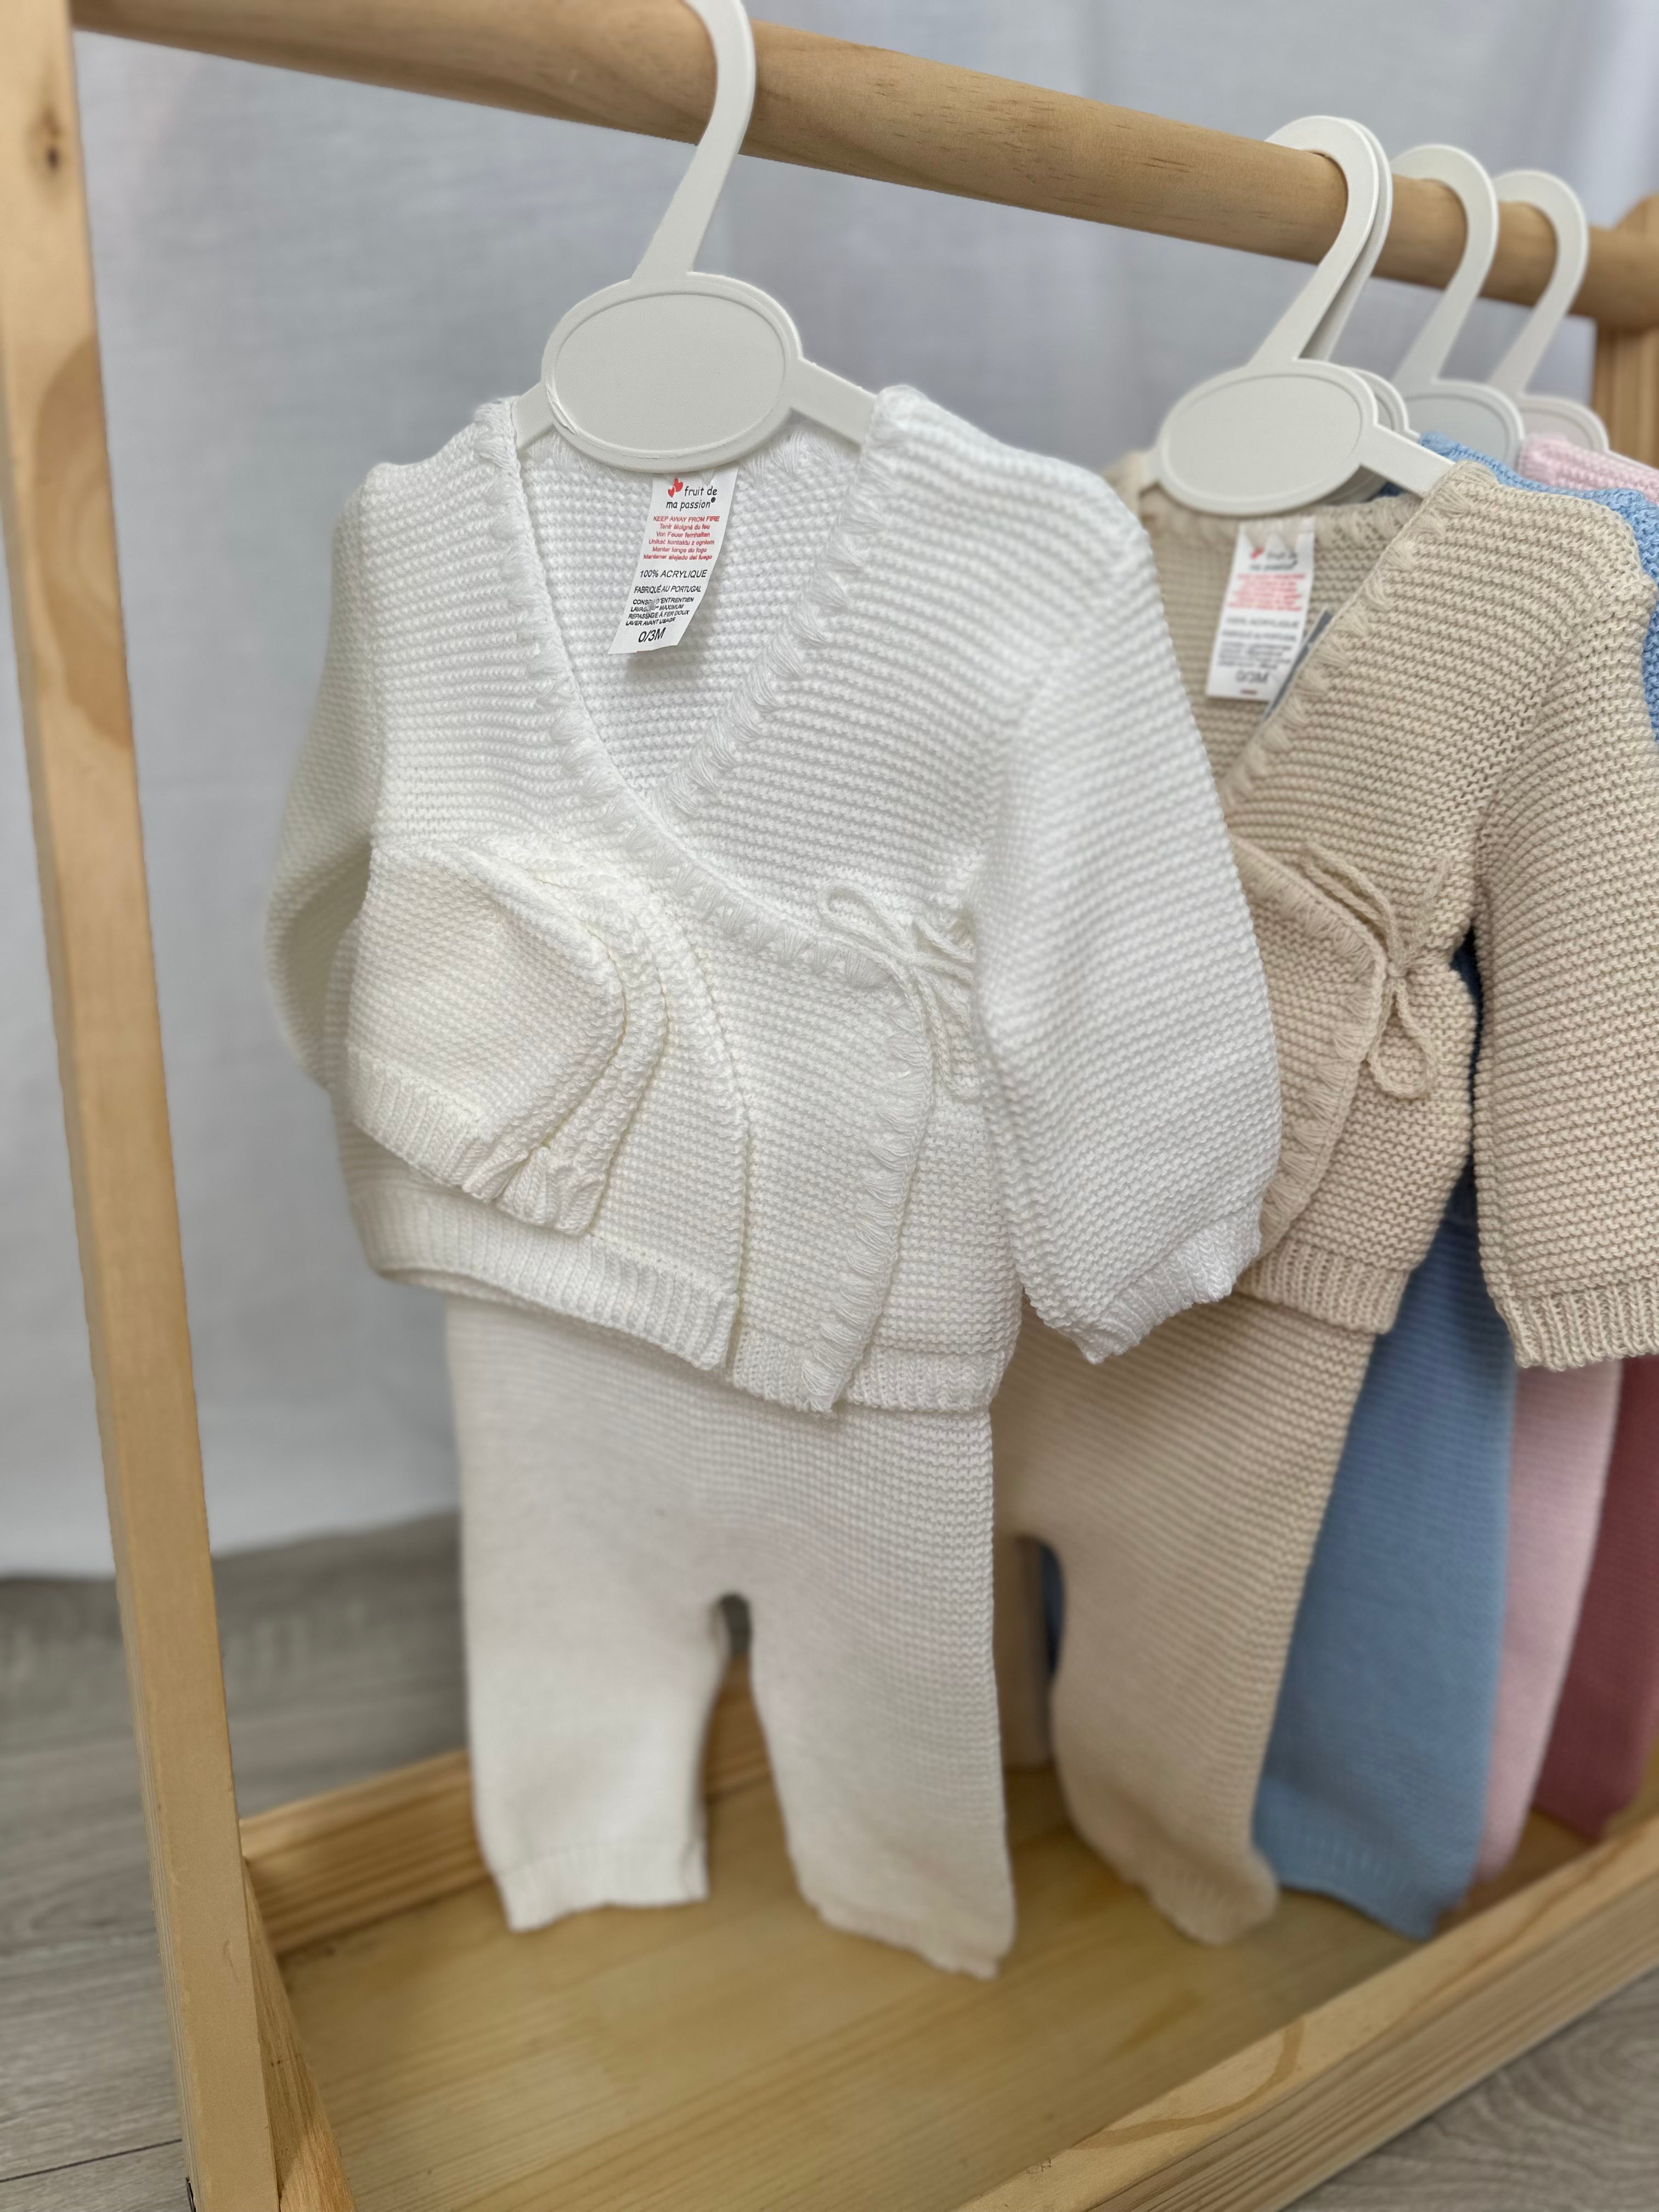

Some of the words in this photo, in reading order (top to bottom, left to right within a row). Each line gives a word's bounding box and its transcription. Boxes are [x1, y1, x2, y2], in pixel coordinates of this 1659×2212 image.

[684, 486, 704, 496] fruit
[707, 486, 718, 495] de
[666, 501, 678, 509] ma
[640, 569, 659, 578] 100%
[660, 569, 708, 578] ACRYLIQUE
[634, 585, 662, 594] FABRIQUÉ
[638, 627, 666, 643] 0/3M
